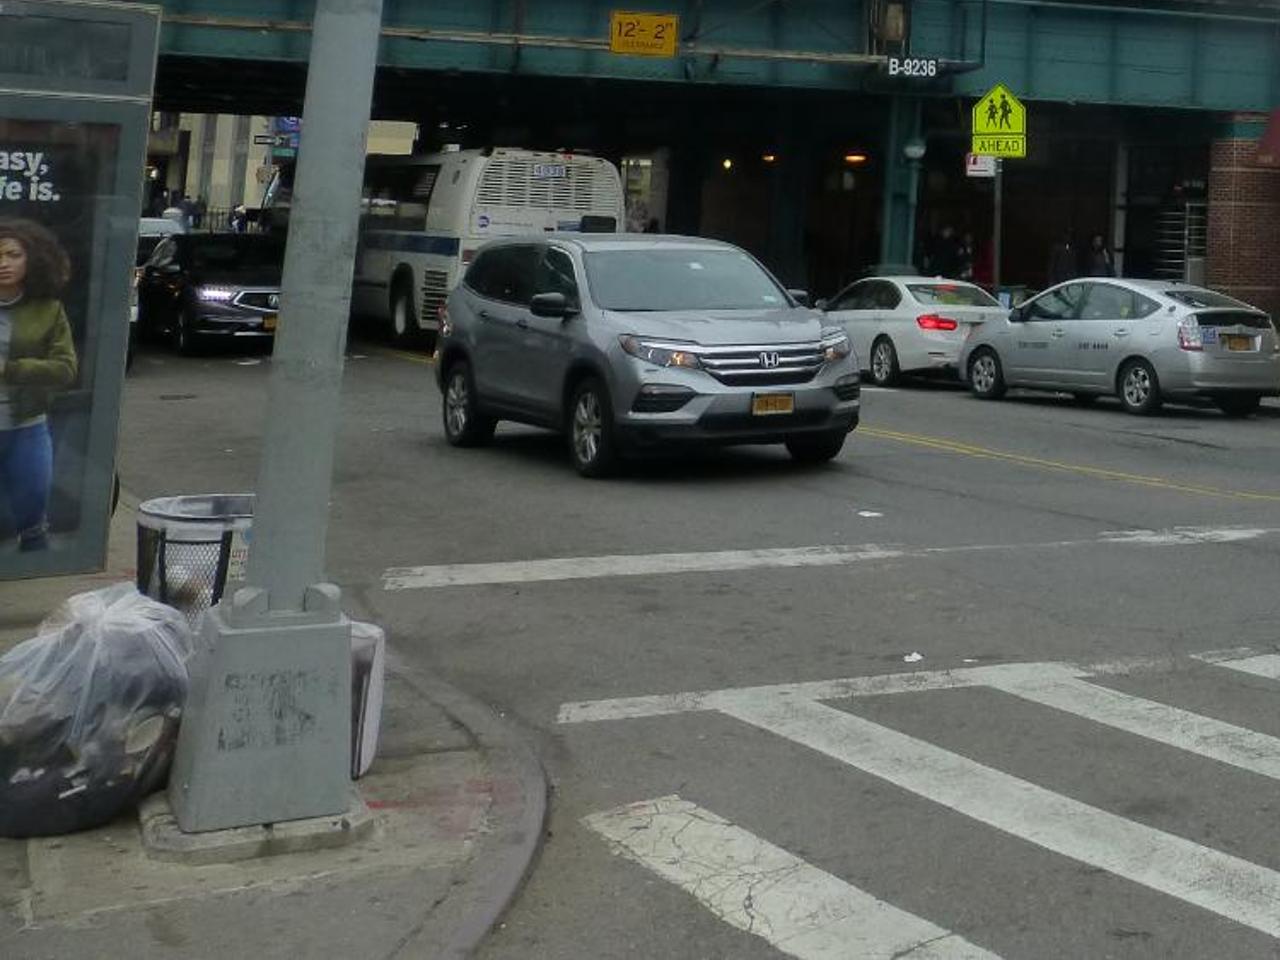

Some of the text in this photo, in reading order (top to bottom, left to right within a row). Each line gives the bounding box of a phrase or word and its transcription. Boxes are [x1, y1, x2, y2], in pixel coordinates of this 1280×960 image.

[889, 58, 937, 76] B-9236
[979, 140, 1020, 152] AHEAD
[29, 176, 60, 200] is.
